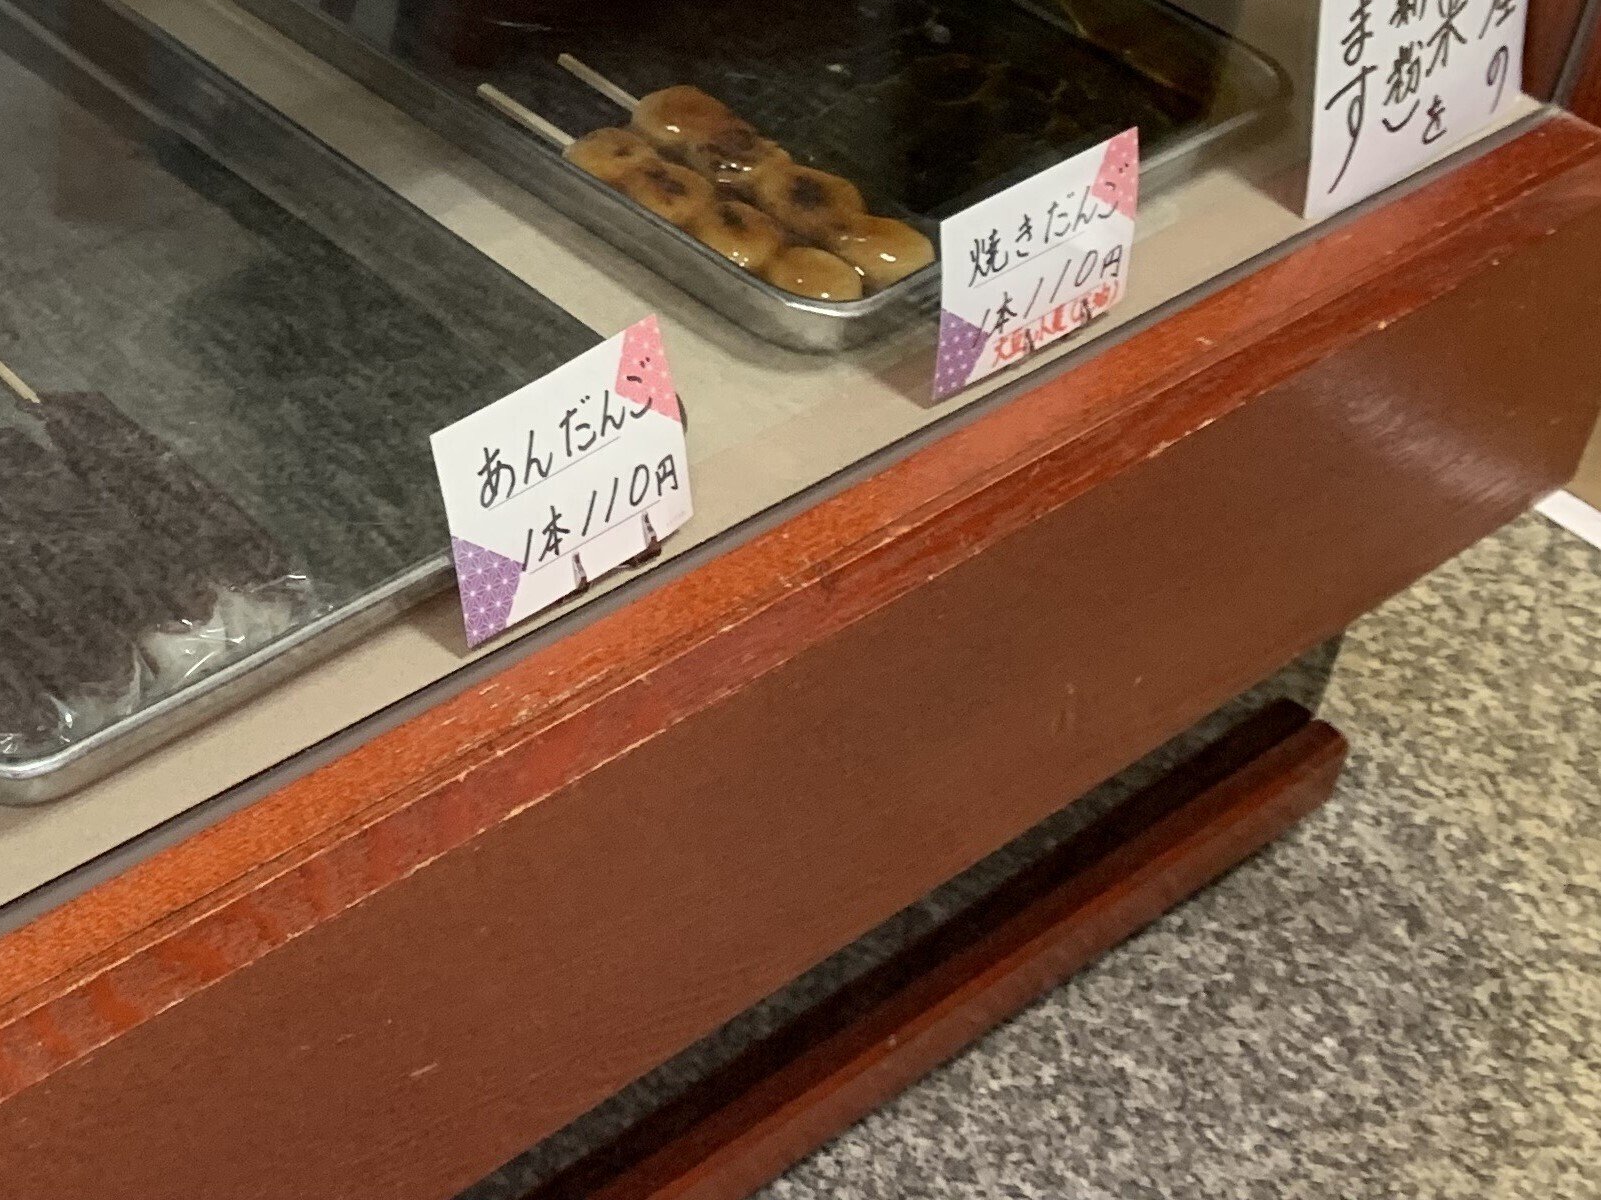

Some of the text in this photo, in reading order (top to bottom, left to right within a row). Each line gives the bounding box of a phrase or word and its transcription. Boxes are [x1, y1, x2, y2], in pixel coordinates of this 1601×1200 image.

[968, 161, 1130, 287] 焼きだんご
[477, 356, 653, 508] あんだんご
